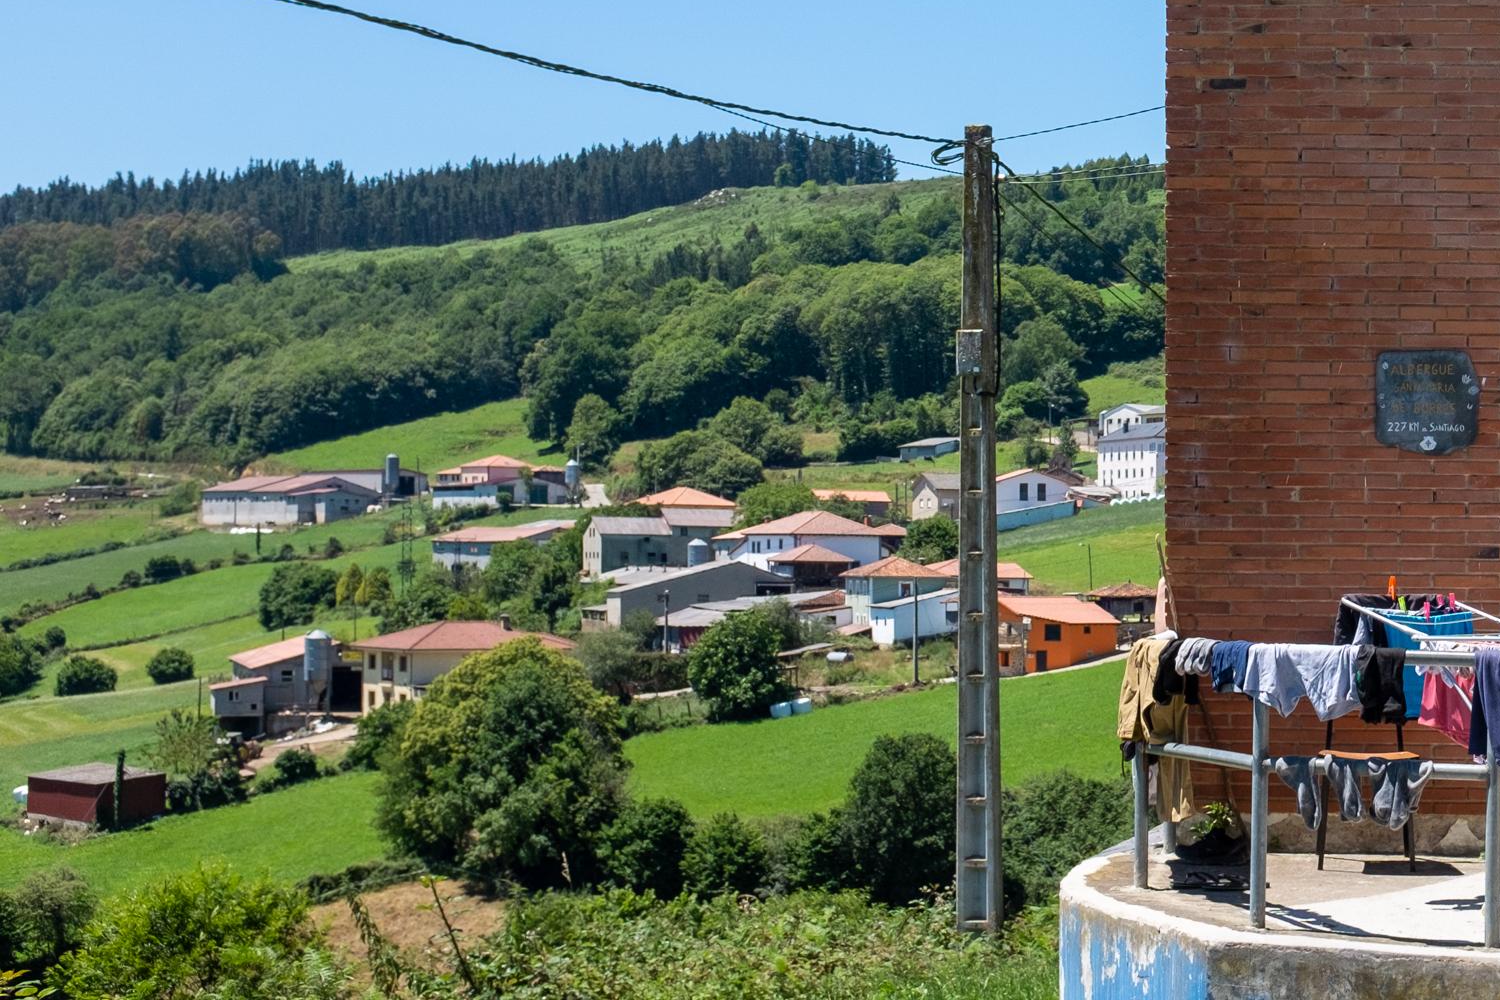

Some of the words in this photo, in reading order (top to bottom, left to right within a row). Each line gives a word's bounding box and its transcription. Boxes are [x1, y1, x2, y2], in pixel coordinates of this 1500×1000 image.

[1391, 363, 1456, 376] ALBERGUE
[1392, 382, 1424, 392] SANTA
[1387, 421, 1408, 432] 227
